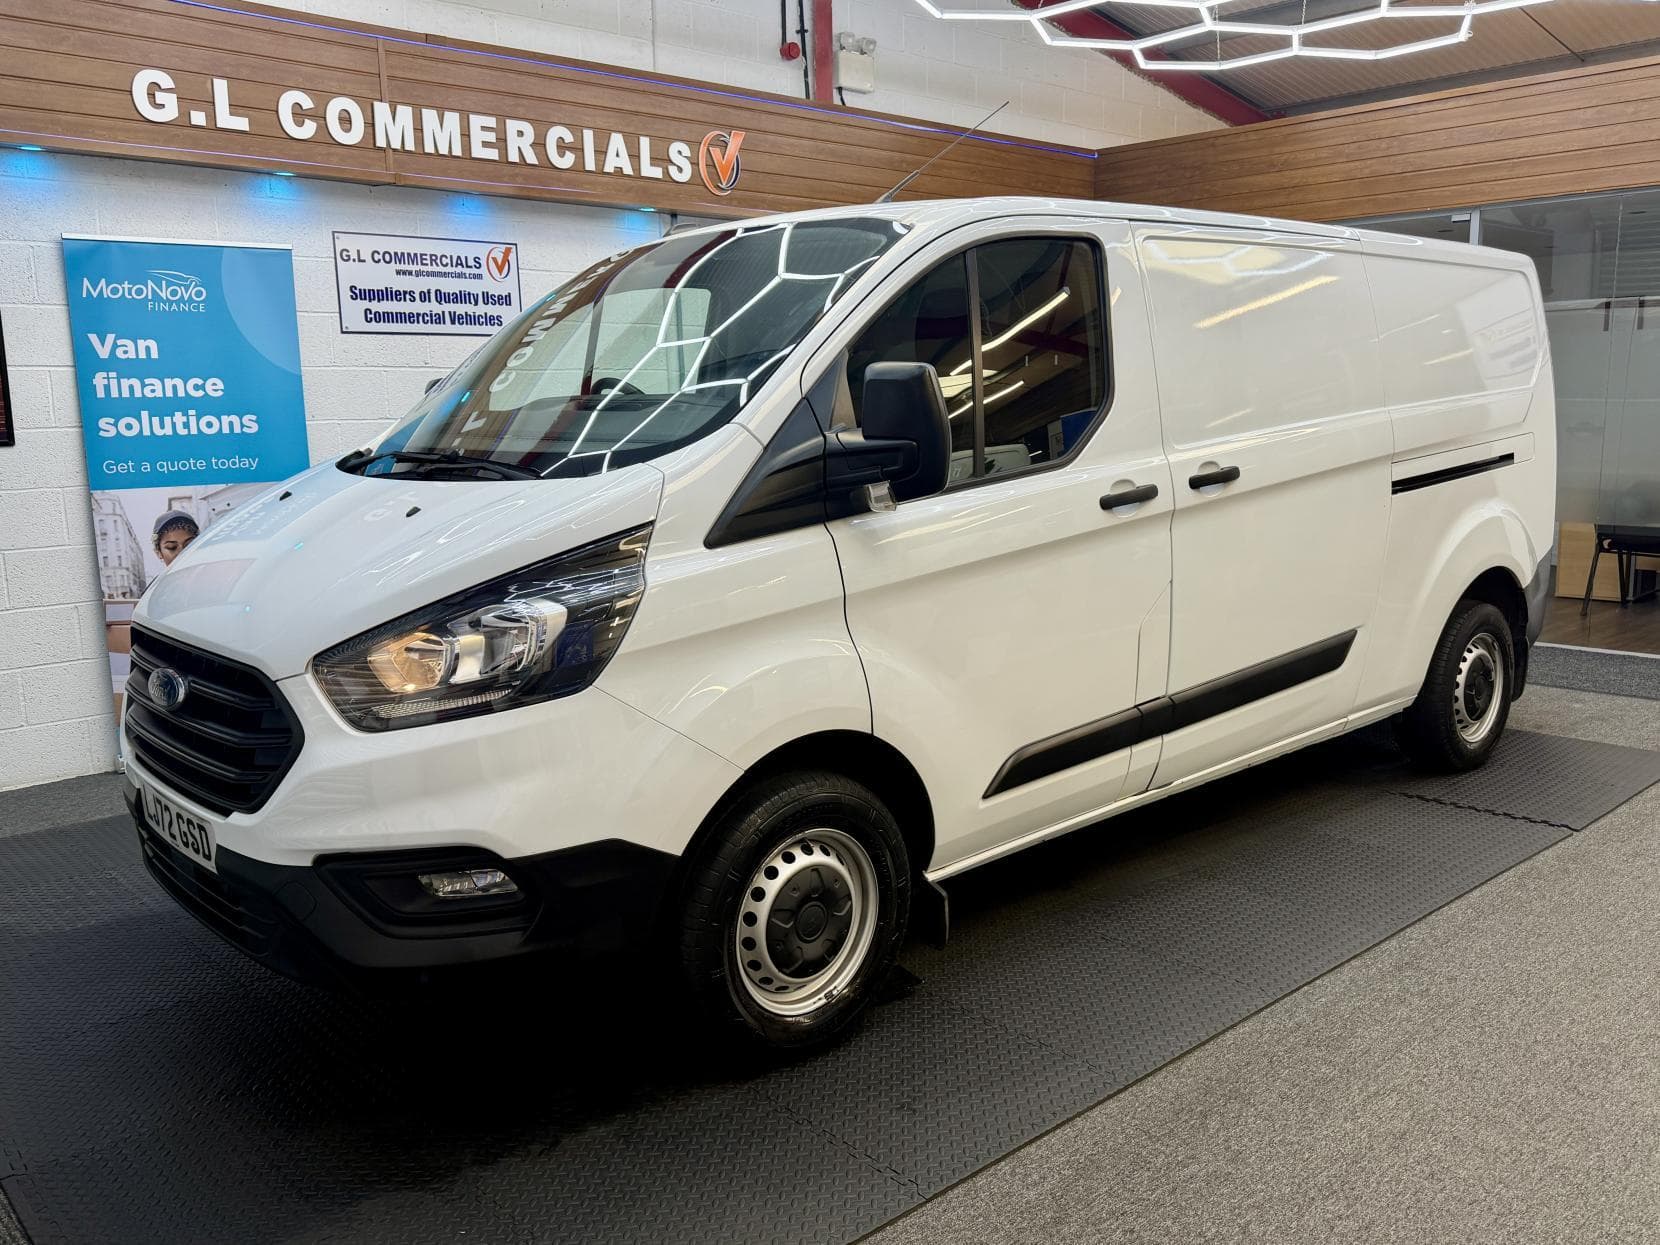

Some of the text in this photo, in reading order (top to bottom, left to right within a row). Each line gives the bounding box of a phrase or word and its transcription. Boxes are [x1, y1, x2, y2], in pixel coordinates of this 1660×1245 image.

[131, 68, 693, 183] G.L COMMERCIALS
[339, 248, 482, 270] G.L COMMERCIALS
[395, 267, 483, 281] www.glcommercials.com
[81, 277, 207, 301] MotoNovo
[349, 285, 512, 307] Suppliers of Quality Used
[148, 301, 206, 312] FINANCE
[364, 308, 503, 327] Commercial Vehicles
[87, 333, 159, 359] Van
[92, 371, 225, 399] finance
[97, 409, 259, 437] solutions
[103, 455, 259, 474] Get a quote today
[176, 811, 212, 861] GSD
